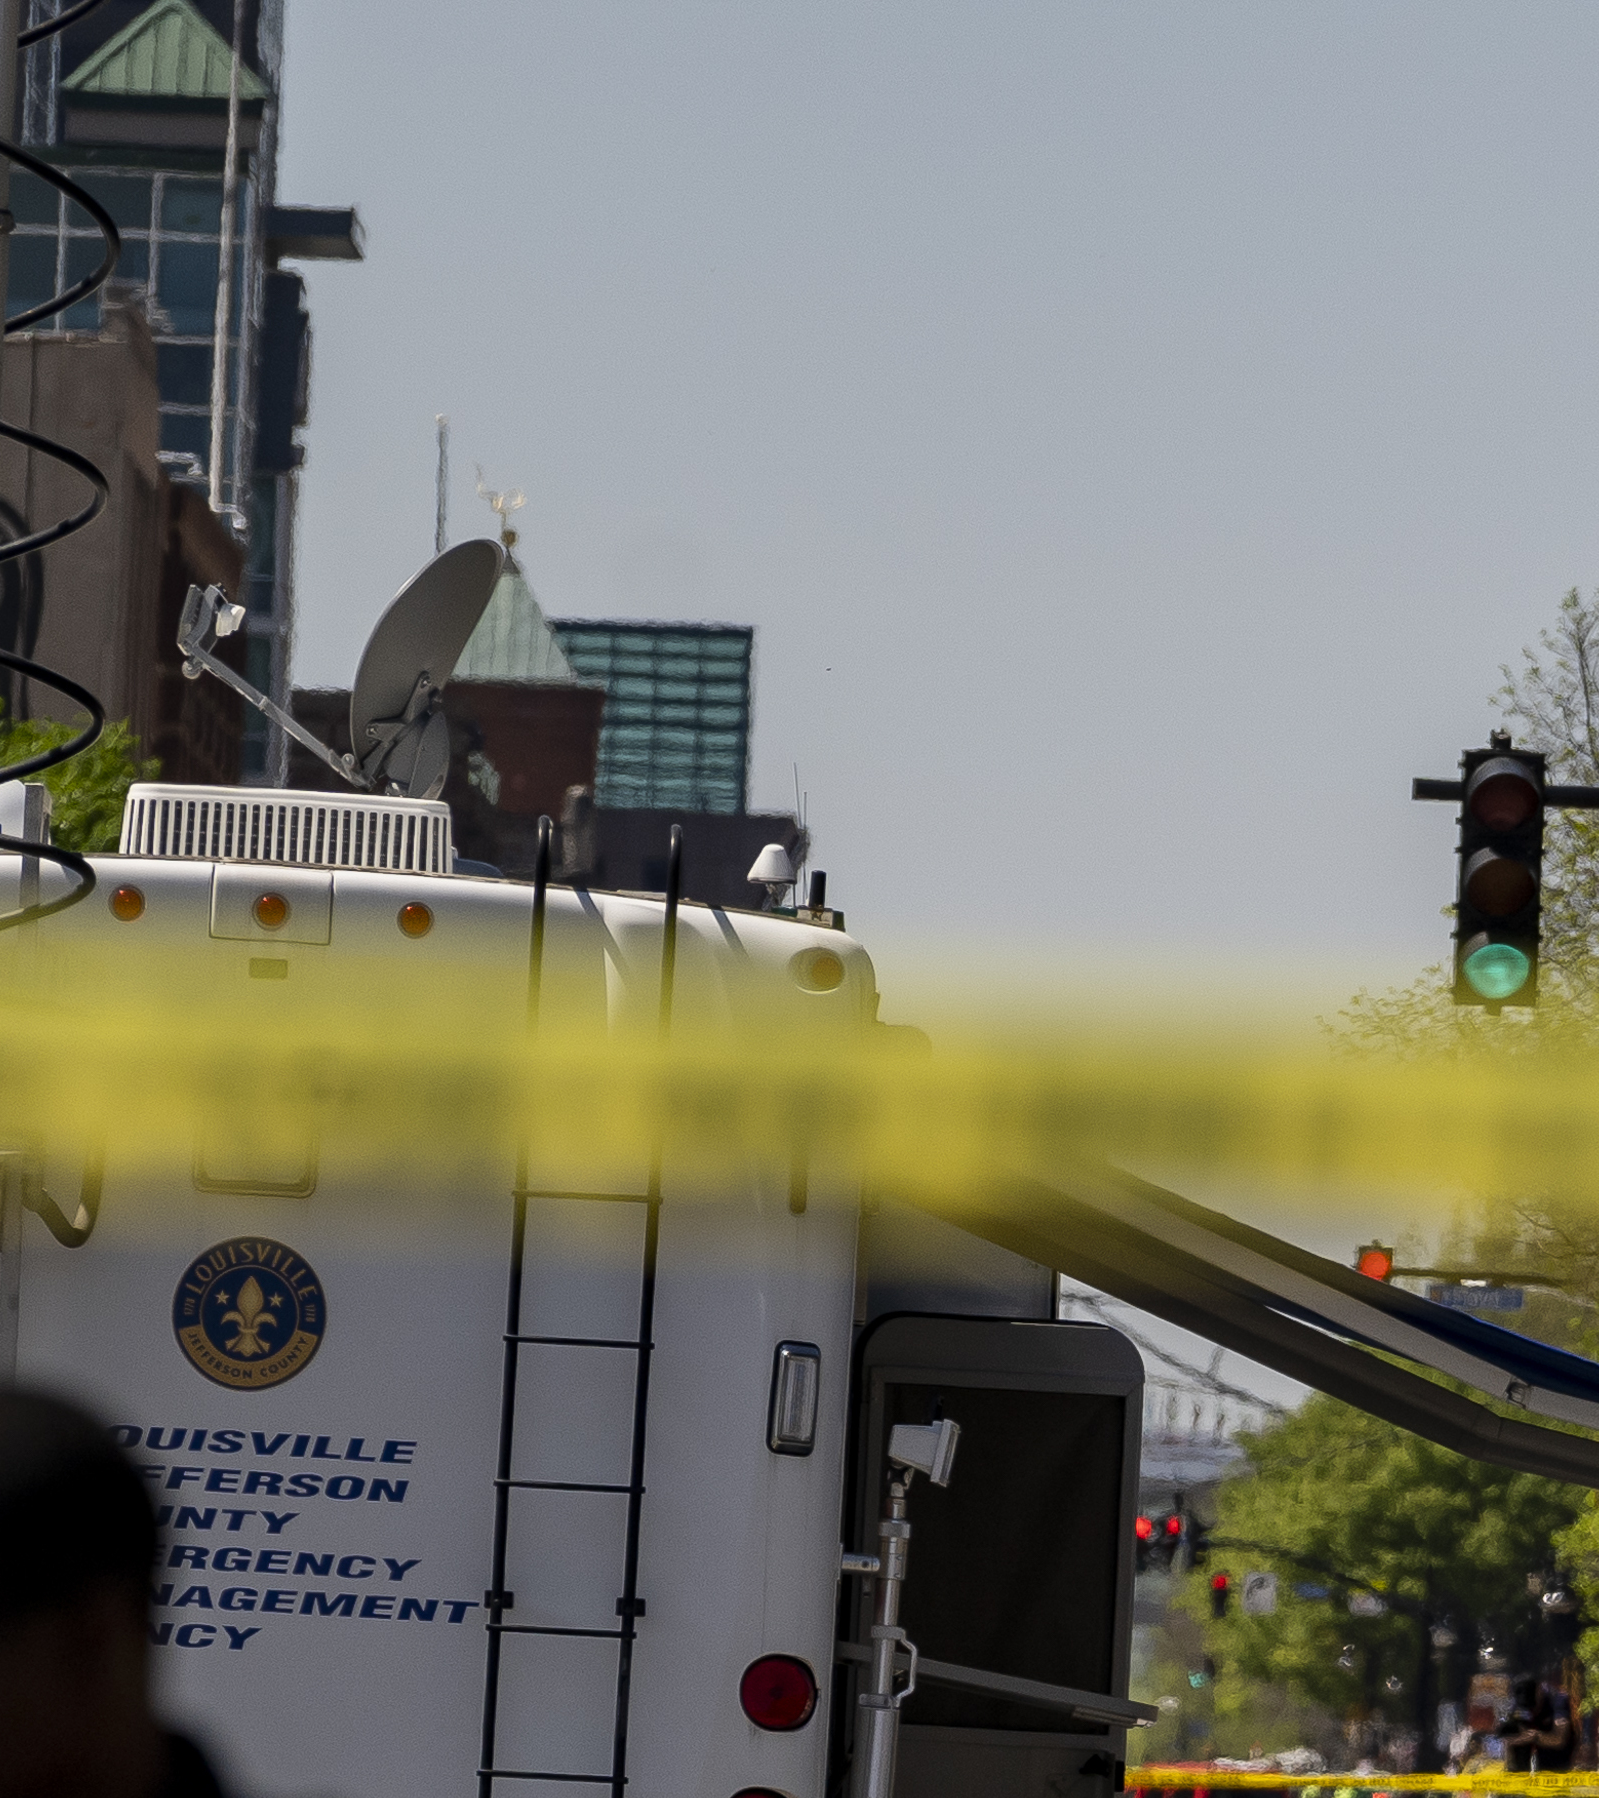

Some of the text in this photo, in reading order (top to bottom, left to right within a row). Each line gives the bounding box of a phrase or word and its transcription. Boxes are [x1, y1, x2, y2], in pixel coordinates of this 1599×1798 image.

[186, 1242, 318, 1299] LOUISVILLE
[187, 1332, 308, 1379] JEFFERSON COUNTY
[106, 1424, 418, 1464] OUISVILLE
[137, 1464, 410, 1503] FFERSON
